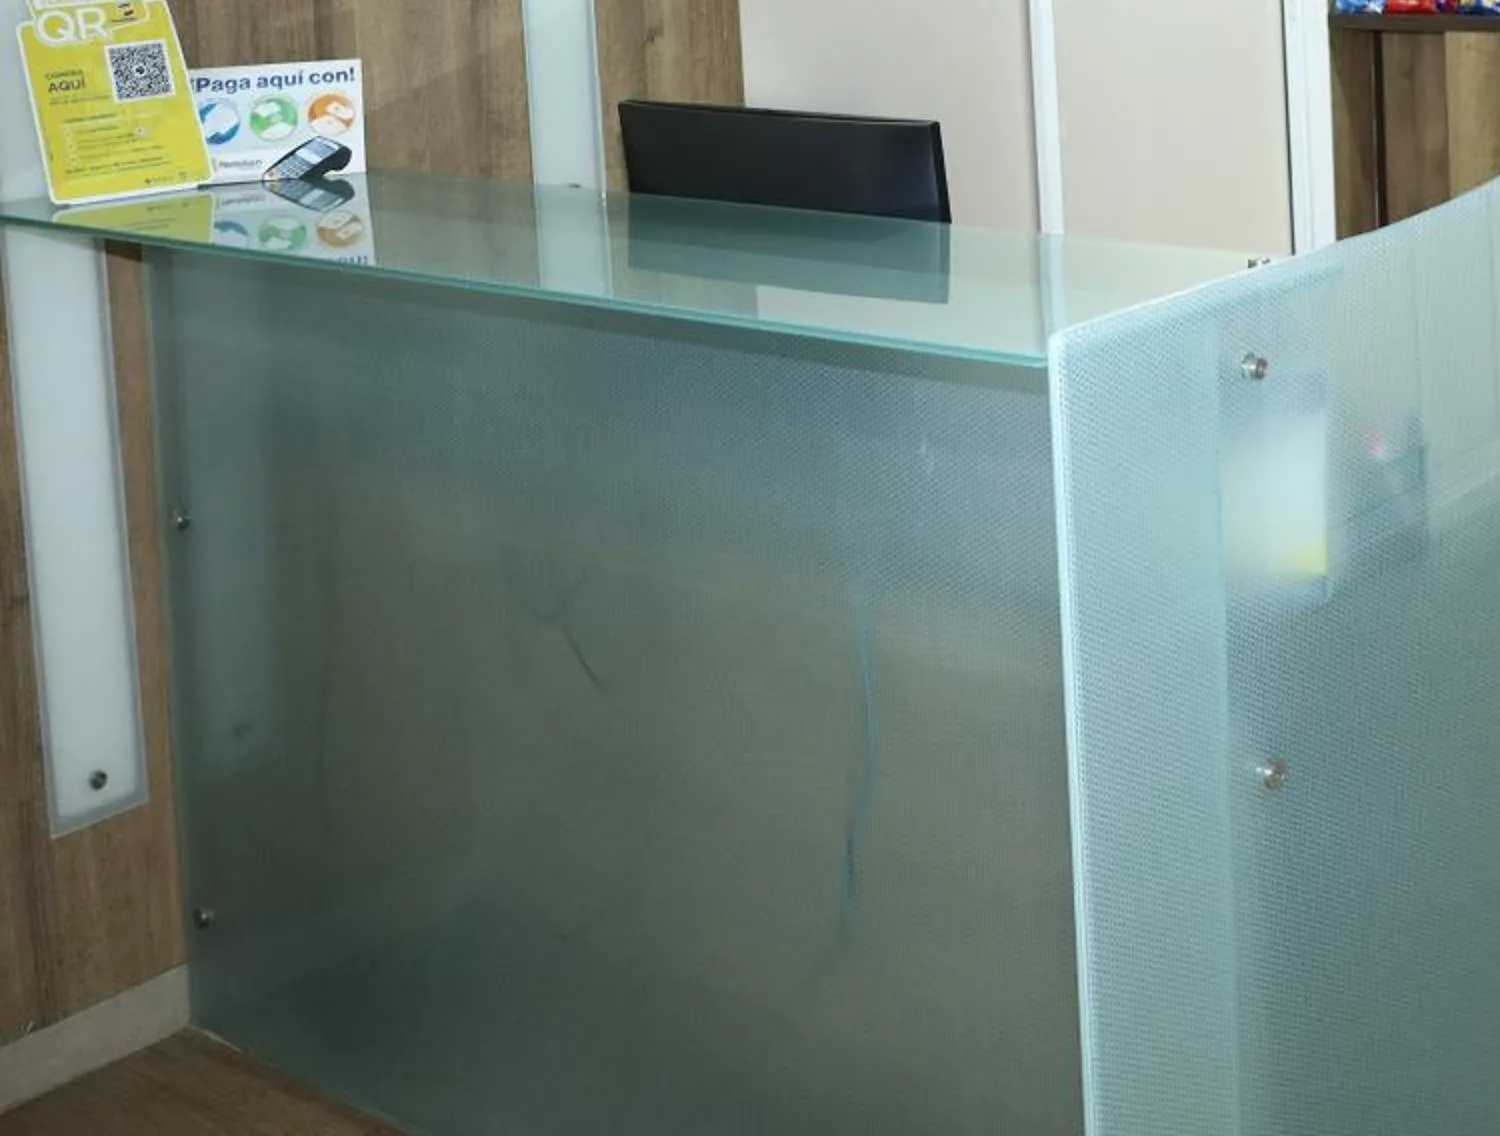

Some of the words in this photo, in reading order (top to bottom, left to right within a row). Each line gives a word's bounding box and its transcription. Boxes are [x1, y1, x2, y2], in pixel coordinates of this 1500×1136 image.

[36, 7, 112, 44] QR
[255, 71, 304, 89] aquí
[308, 67, 355, 84] con!
